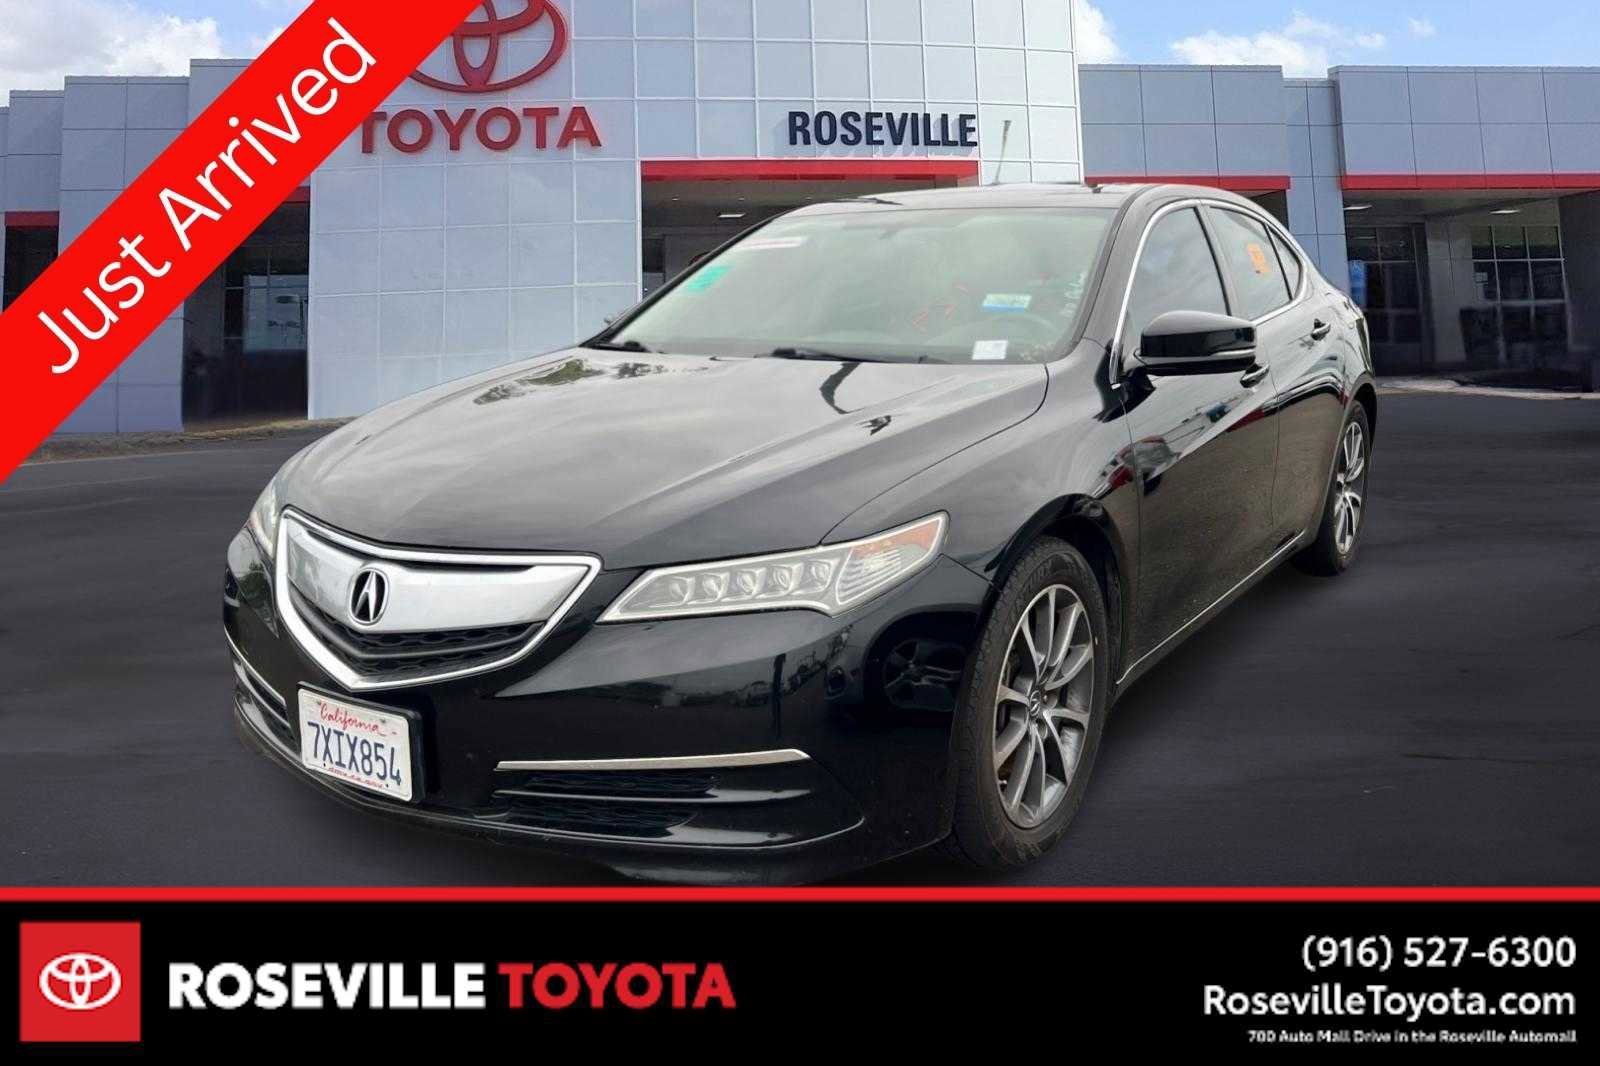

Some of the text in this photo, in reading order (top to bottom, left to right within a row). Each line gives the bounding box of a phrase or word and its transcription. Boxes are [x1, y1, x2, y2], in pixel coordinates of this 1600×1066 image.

[361, 106, 602, 154] TOYOTA
[788, 111, 978, 147] ROSEVILLE
[320, 702, 387, 737] California
[307, 720, 402, 786] 7XIX854
